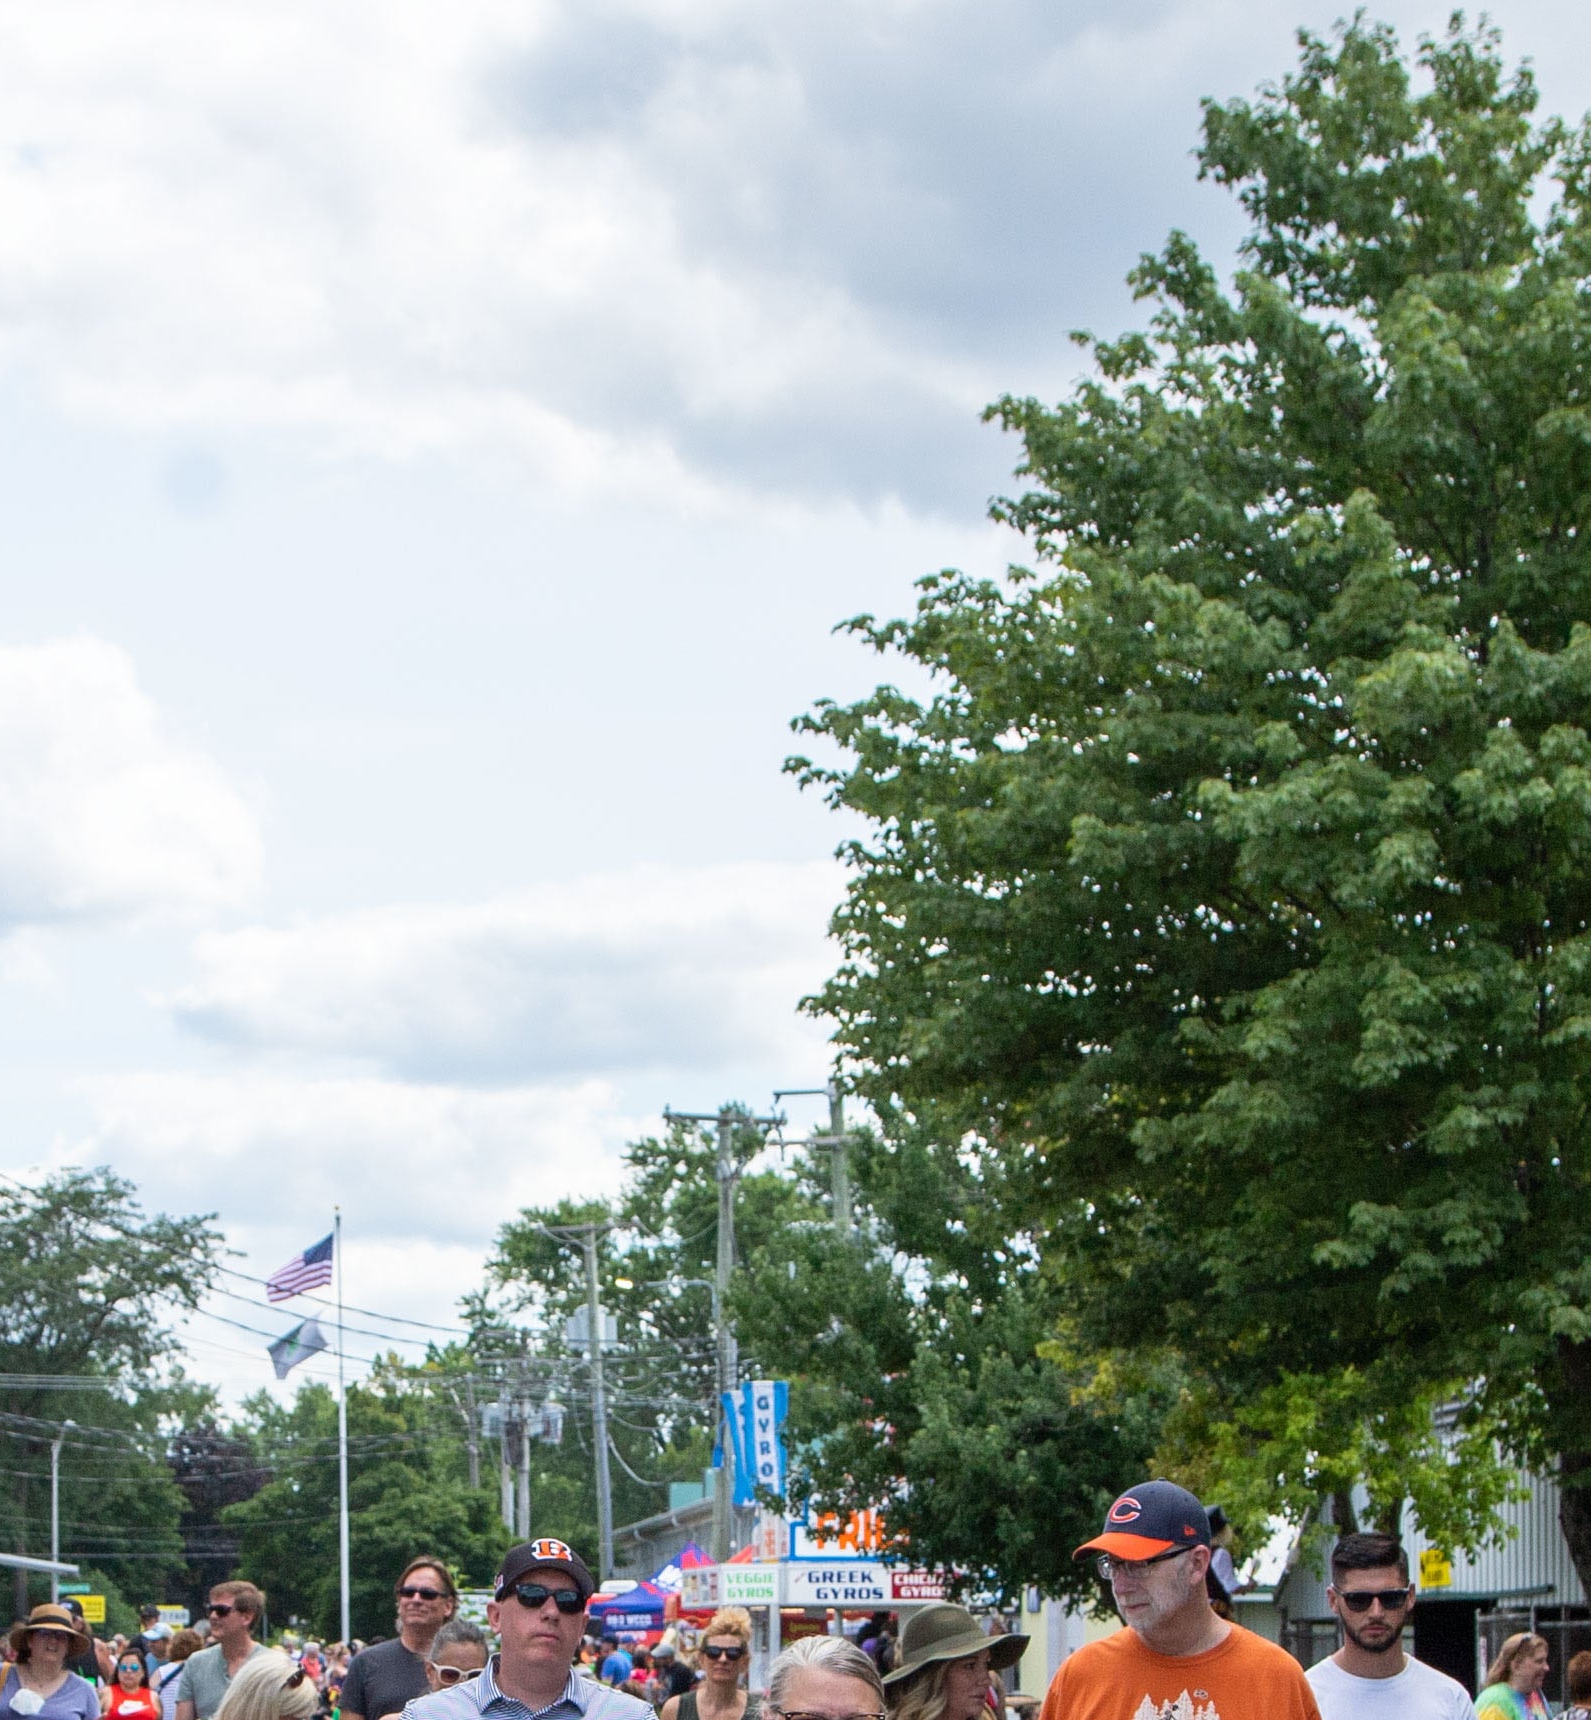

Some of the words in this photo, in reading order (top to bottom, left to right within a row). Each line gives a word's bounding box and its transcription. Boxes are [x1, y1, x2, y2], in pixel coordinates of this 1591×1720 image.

[726, 1572, 776, 1584] VEGGIE
[807, 1570, 874, 1584] GREEK
[727, 1586, 775, 1599] GYROS
[816, 1586, 884, 1600] GYROS
